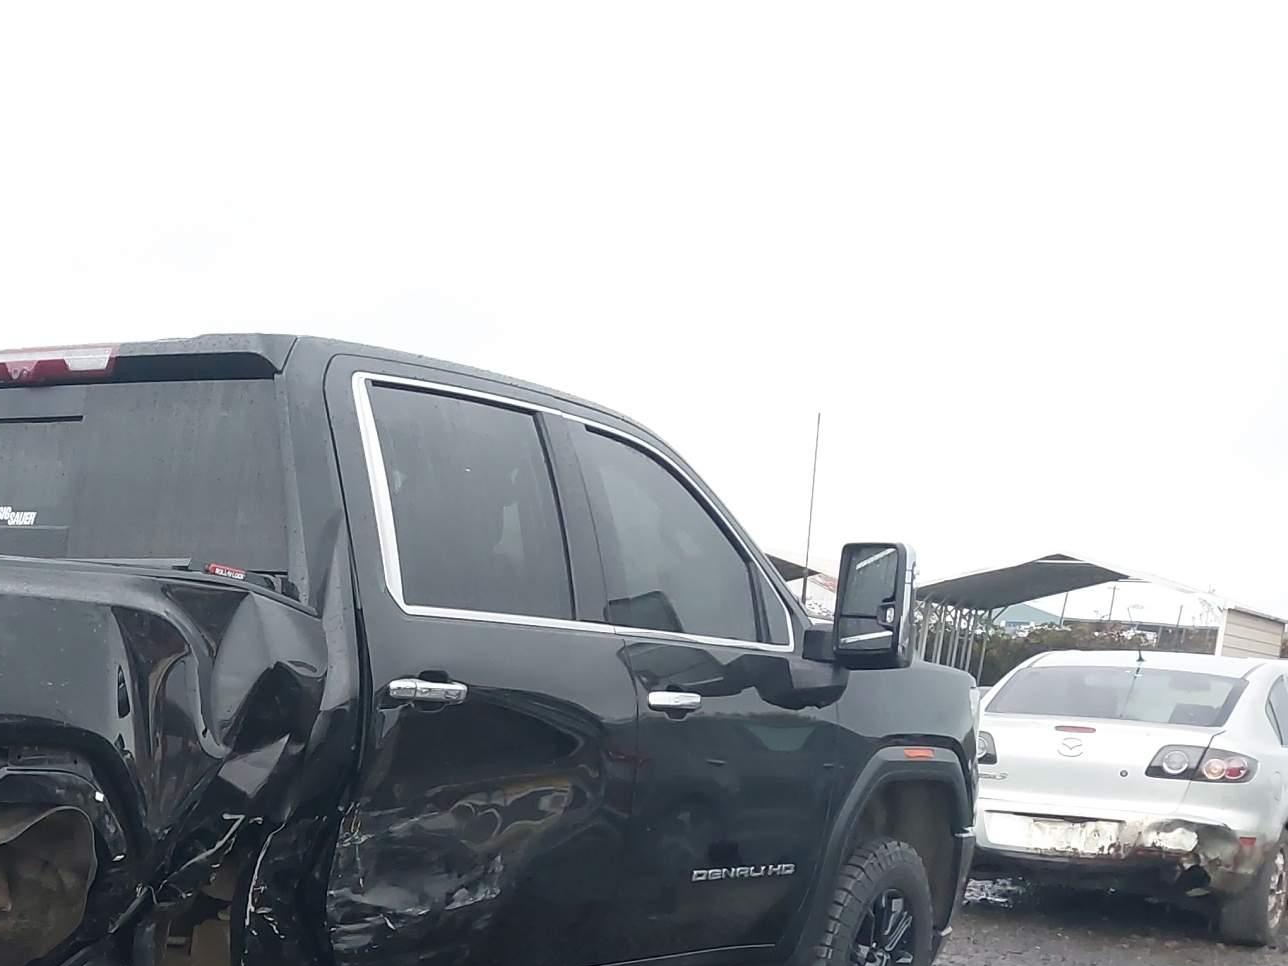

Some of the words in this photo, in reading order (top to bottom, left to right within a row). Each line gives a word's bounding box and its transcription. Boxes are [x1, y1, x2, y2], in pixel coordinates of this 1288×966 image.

[7, 511, 37, 525] SAUER
[692, 865, 766, 882] DENALI
[768, 863, 795, 876] HD
